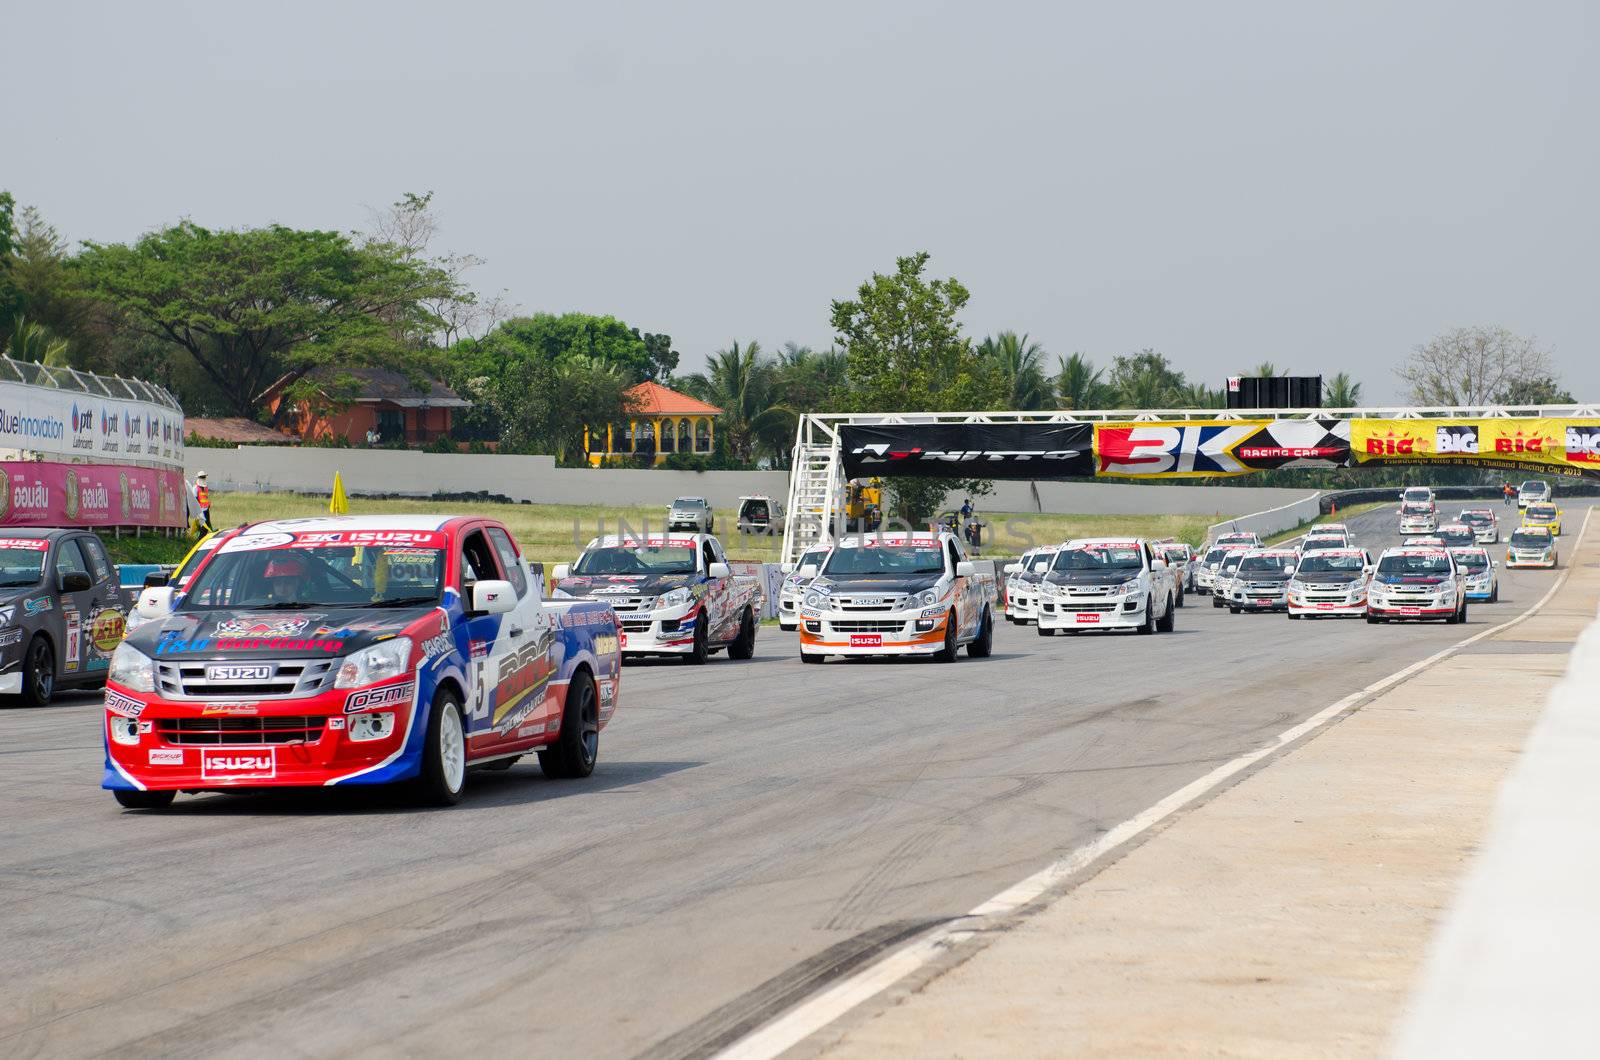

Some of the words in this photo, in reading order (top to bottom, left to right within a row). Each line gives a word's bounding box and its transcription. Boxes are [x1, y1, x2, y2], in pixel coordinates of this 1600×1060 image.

[80, 409, 93, 433] ptt
[108, 412, 118, 437] ptt
[131, 415, 141, 439] ptt
[73, 436, 93, 449] Lubricants
[1243, 449, 1288, 457] RACING
[1293, 449, 1319, 457] CAR
[1466, 458, 1479, 466] Big
[1483, 459, 1515, 468] Thailand
[1518, 462, 1545, 473] Racing
[1564, 467, 1582, 476] 2013
[349, 533, 432, 543] ISUZU
[851, 637, 881, 645] ISUZU
[210, 666, 270, 680] ISUZU
[476, 661, 485, 711] 5
[344, 681, 415, 714] COSMIS
[205, 757, 271, 770] ISUZU
